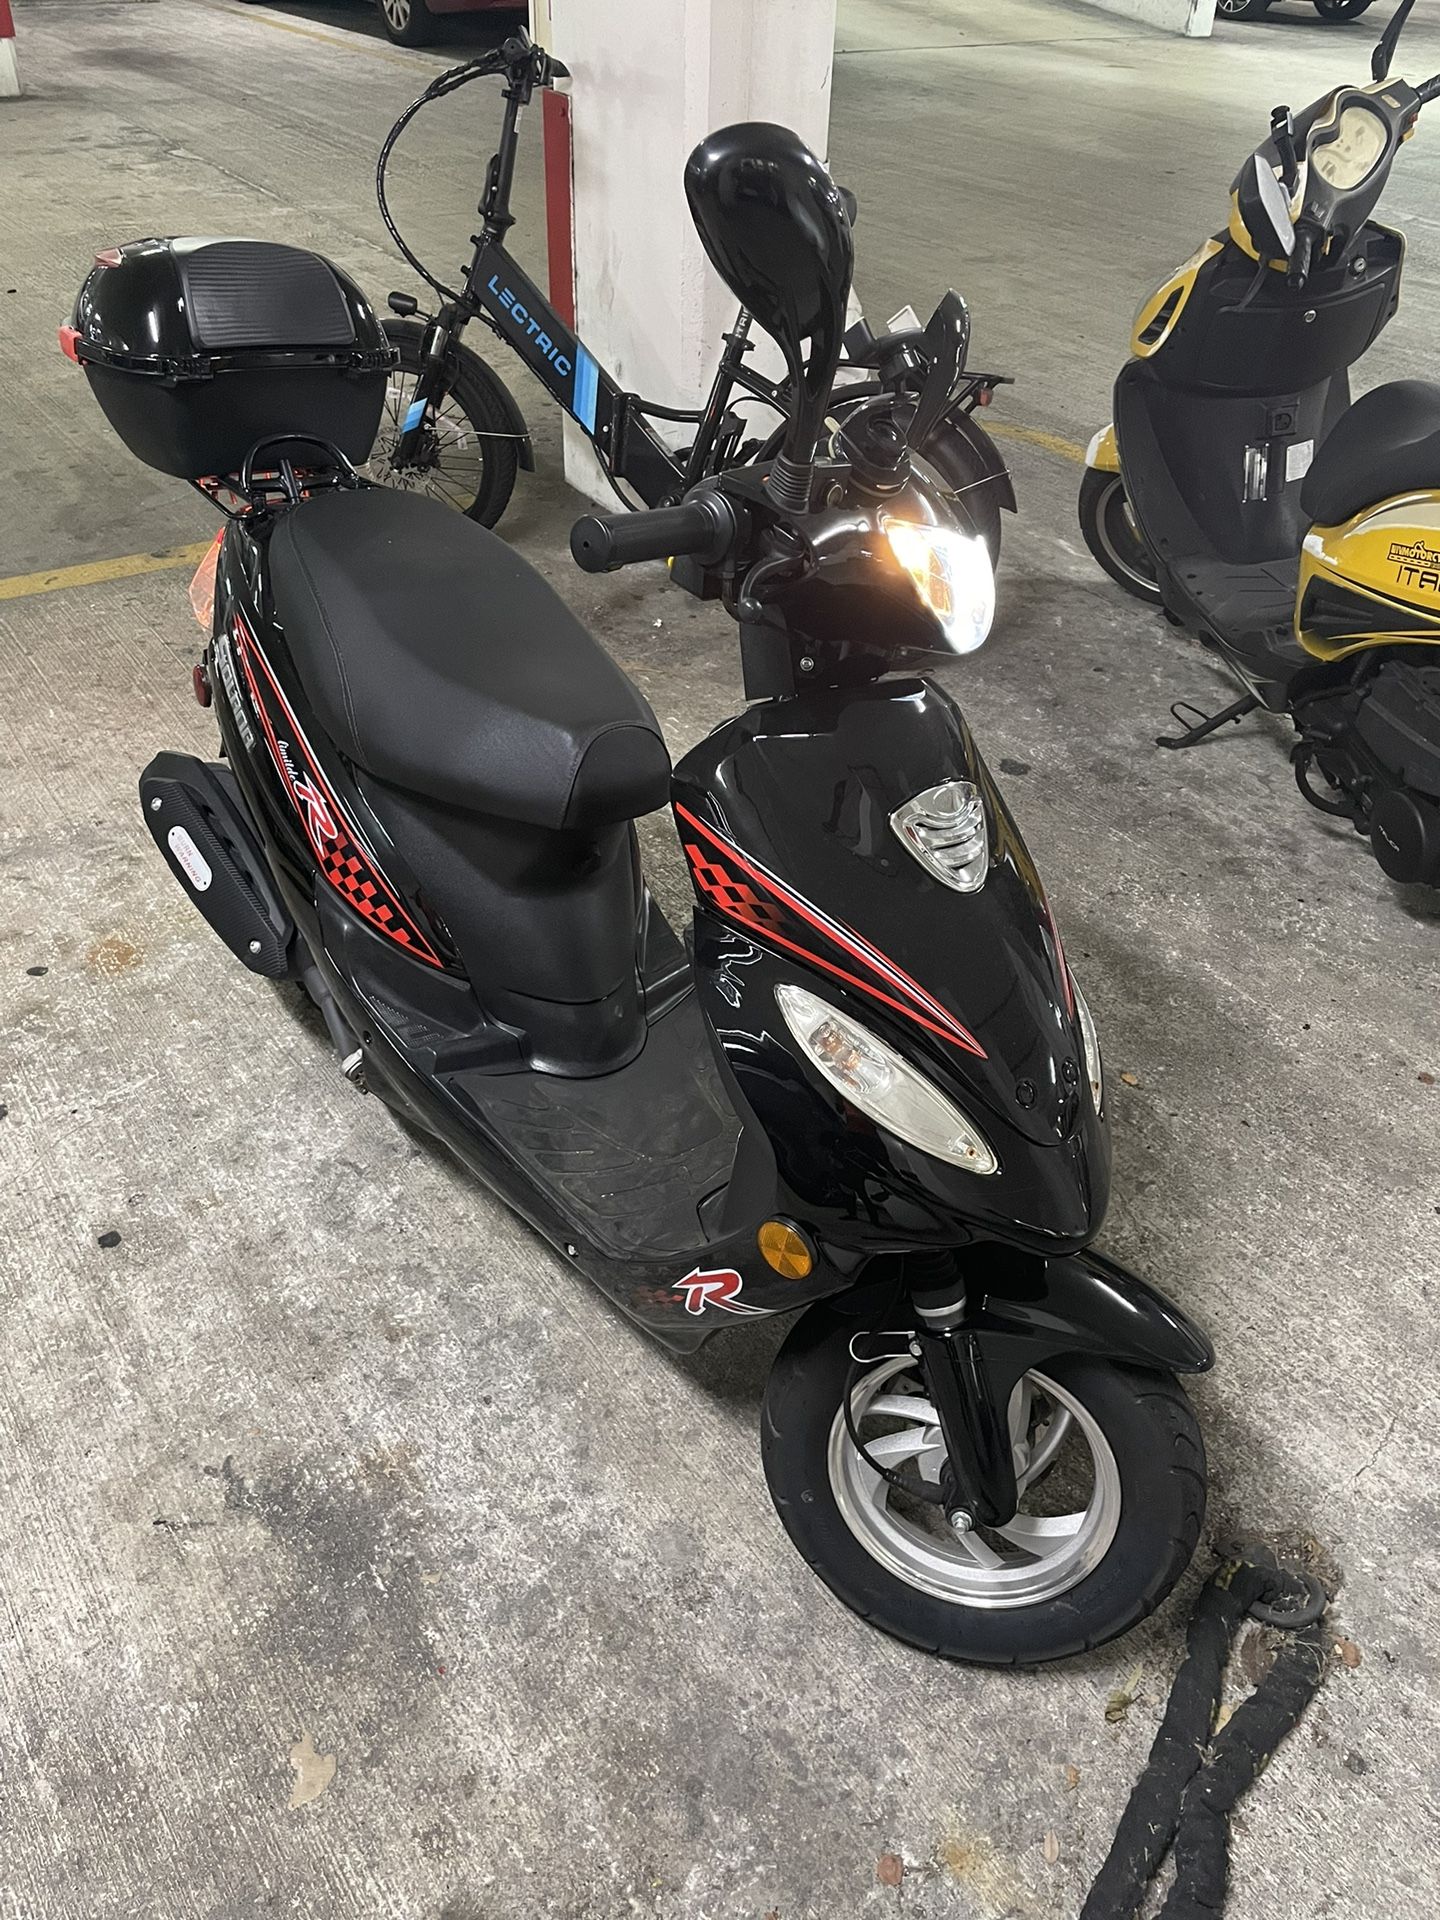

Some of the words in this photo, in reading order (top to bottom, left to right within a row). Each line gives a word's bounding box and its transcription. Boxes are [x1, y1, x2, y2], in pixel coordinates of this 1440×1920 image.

[488, 274, 571, 377] LECTRIC
[1396, 565, 1440, 592] ITA
[177, 835, 193, 856] BURN
[175, 844, 201, 883] WARNING
